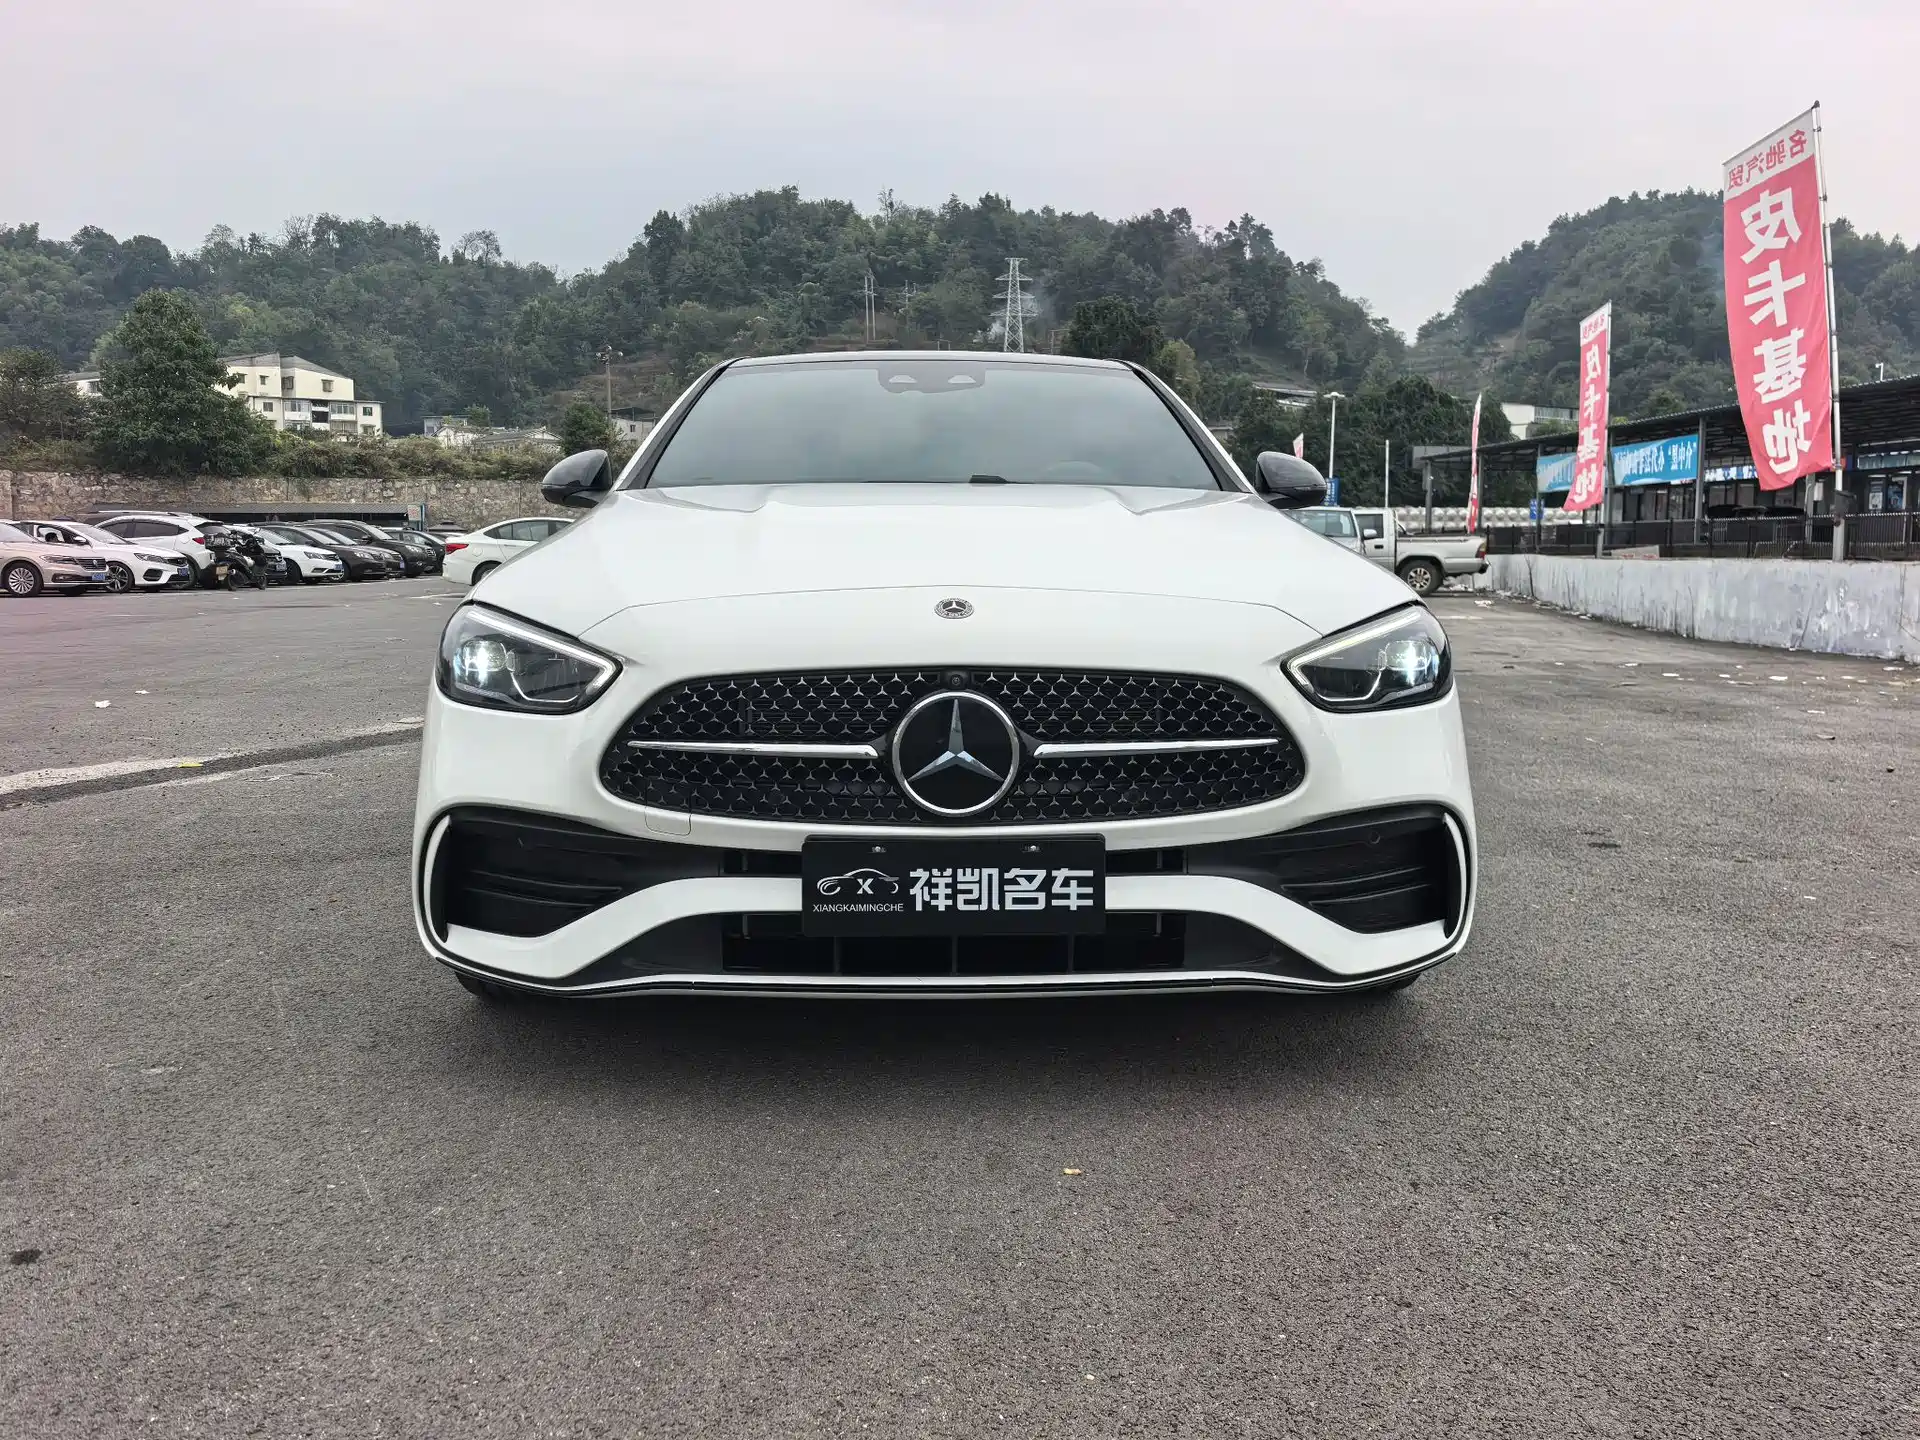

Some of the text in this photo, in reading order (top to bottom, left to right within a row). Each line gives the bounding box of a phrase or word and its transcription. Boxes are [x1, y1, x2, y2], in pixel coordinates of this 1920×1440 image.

[909, 867, 1094, 911] 祥凯名车
[813, 903, 904, 913] XIANGKAIMINGCHE
